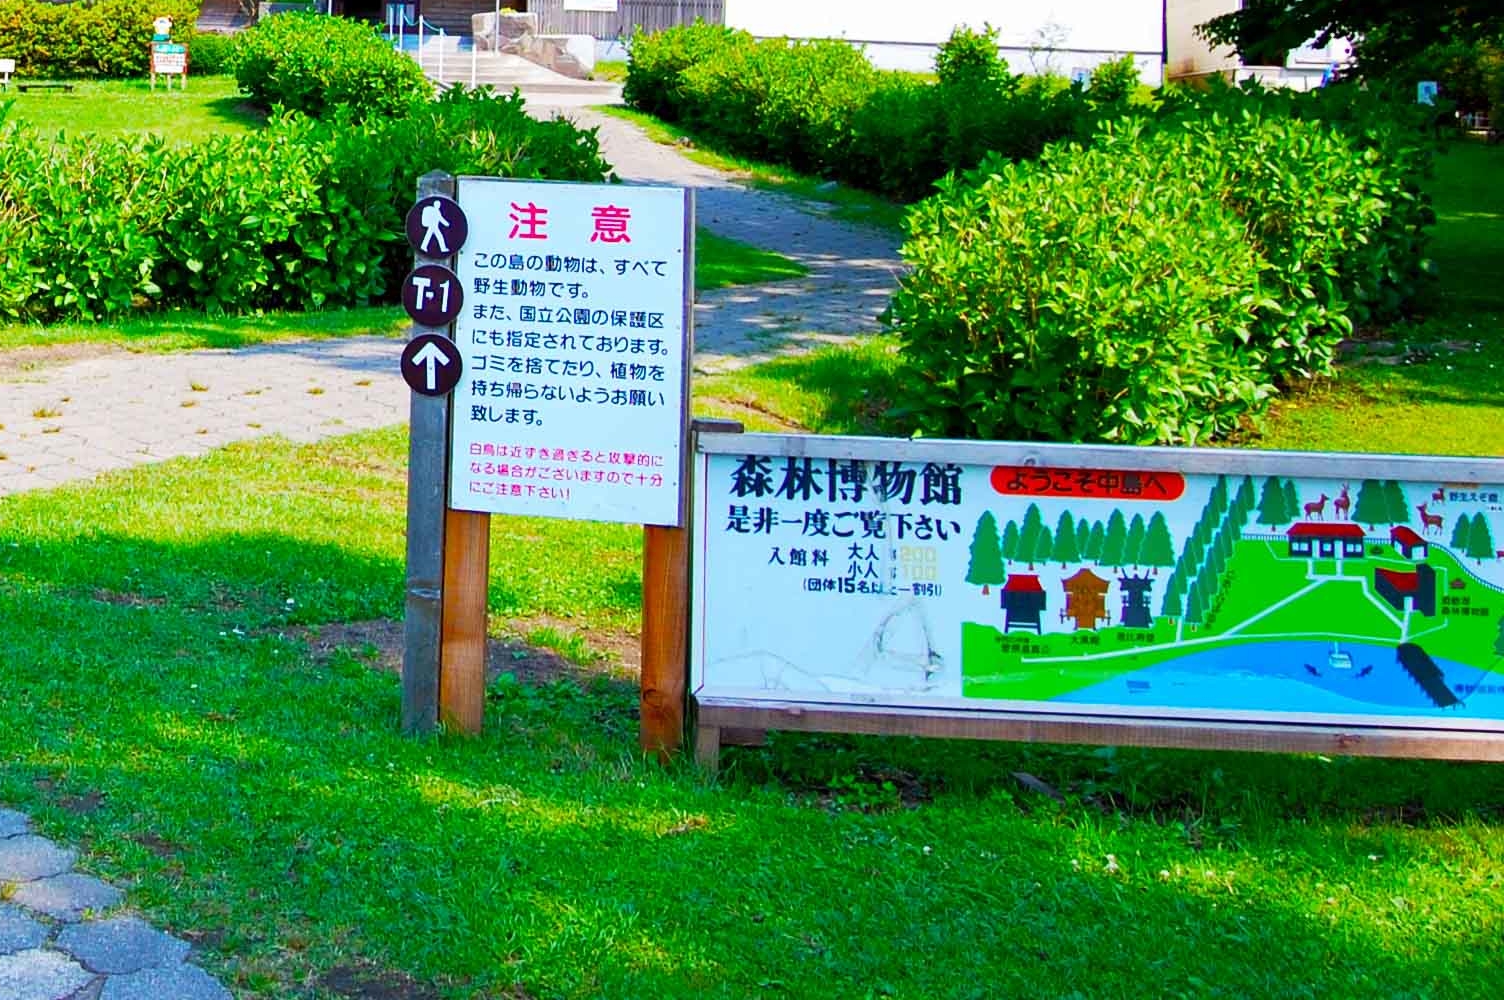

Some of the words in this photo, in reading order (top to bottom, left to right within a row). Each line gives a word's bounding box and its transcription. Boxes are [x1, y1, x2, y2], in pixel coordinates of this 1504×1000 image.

[508, 202, 632, 243] 注意
[474, 252, 668, 277] この島の動物は、すべて
[473, 278, 589, 299] 野生動物です。
[472, 304, 665, 329] また、国立公園の保護区
[472, 329, 668, 356] にも指定されております。
[471, 354, 665, 381] ゴミを捨てたり、植物を
[471, 379, 665, 406] 持ち帰らないようお願い
[470, 404, 543, 426] 致します。
[469, 462, 664, 487] なる場合がございますので十分
[729, 455, 964, 505] 森林博物館
[1007, 471, 1168, 495] ようこそ中島へ
[725, 504, 961, 541] 是非一度ご覧下さい
[768, 547, 830, 567] 入館料
